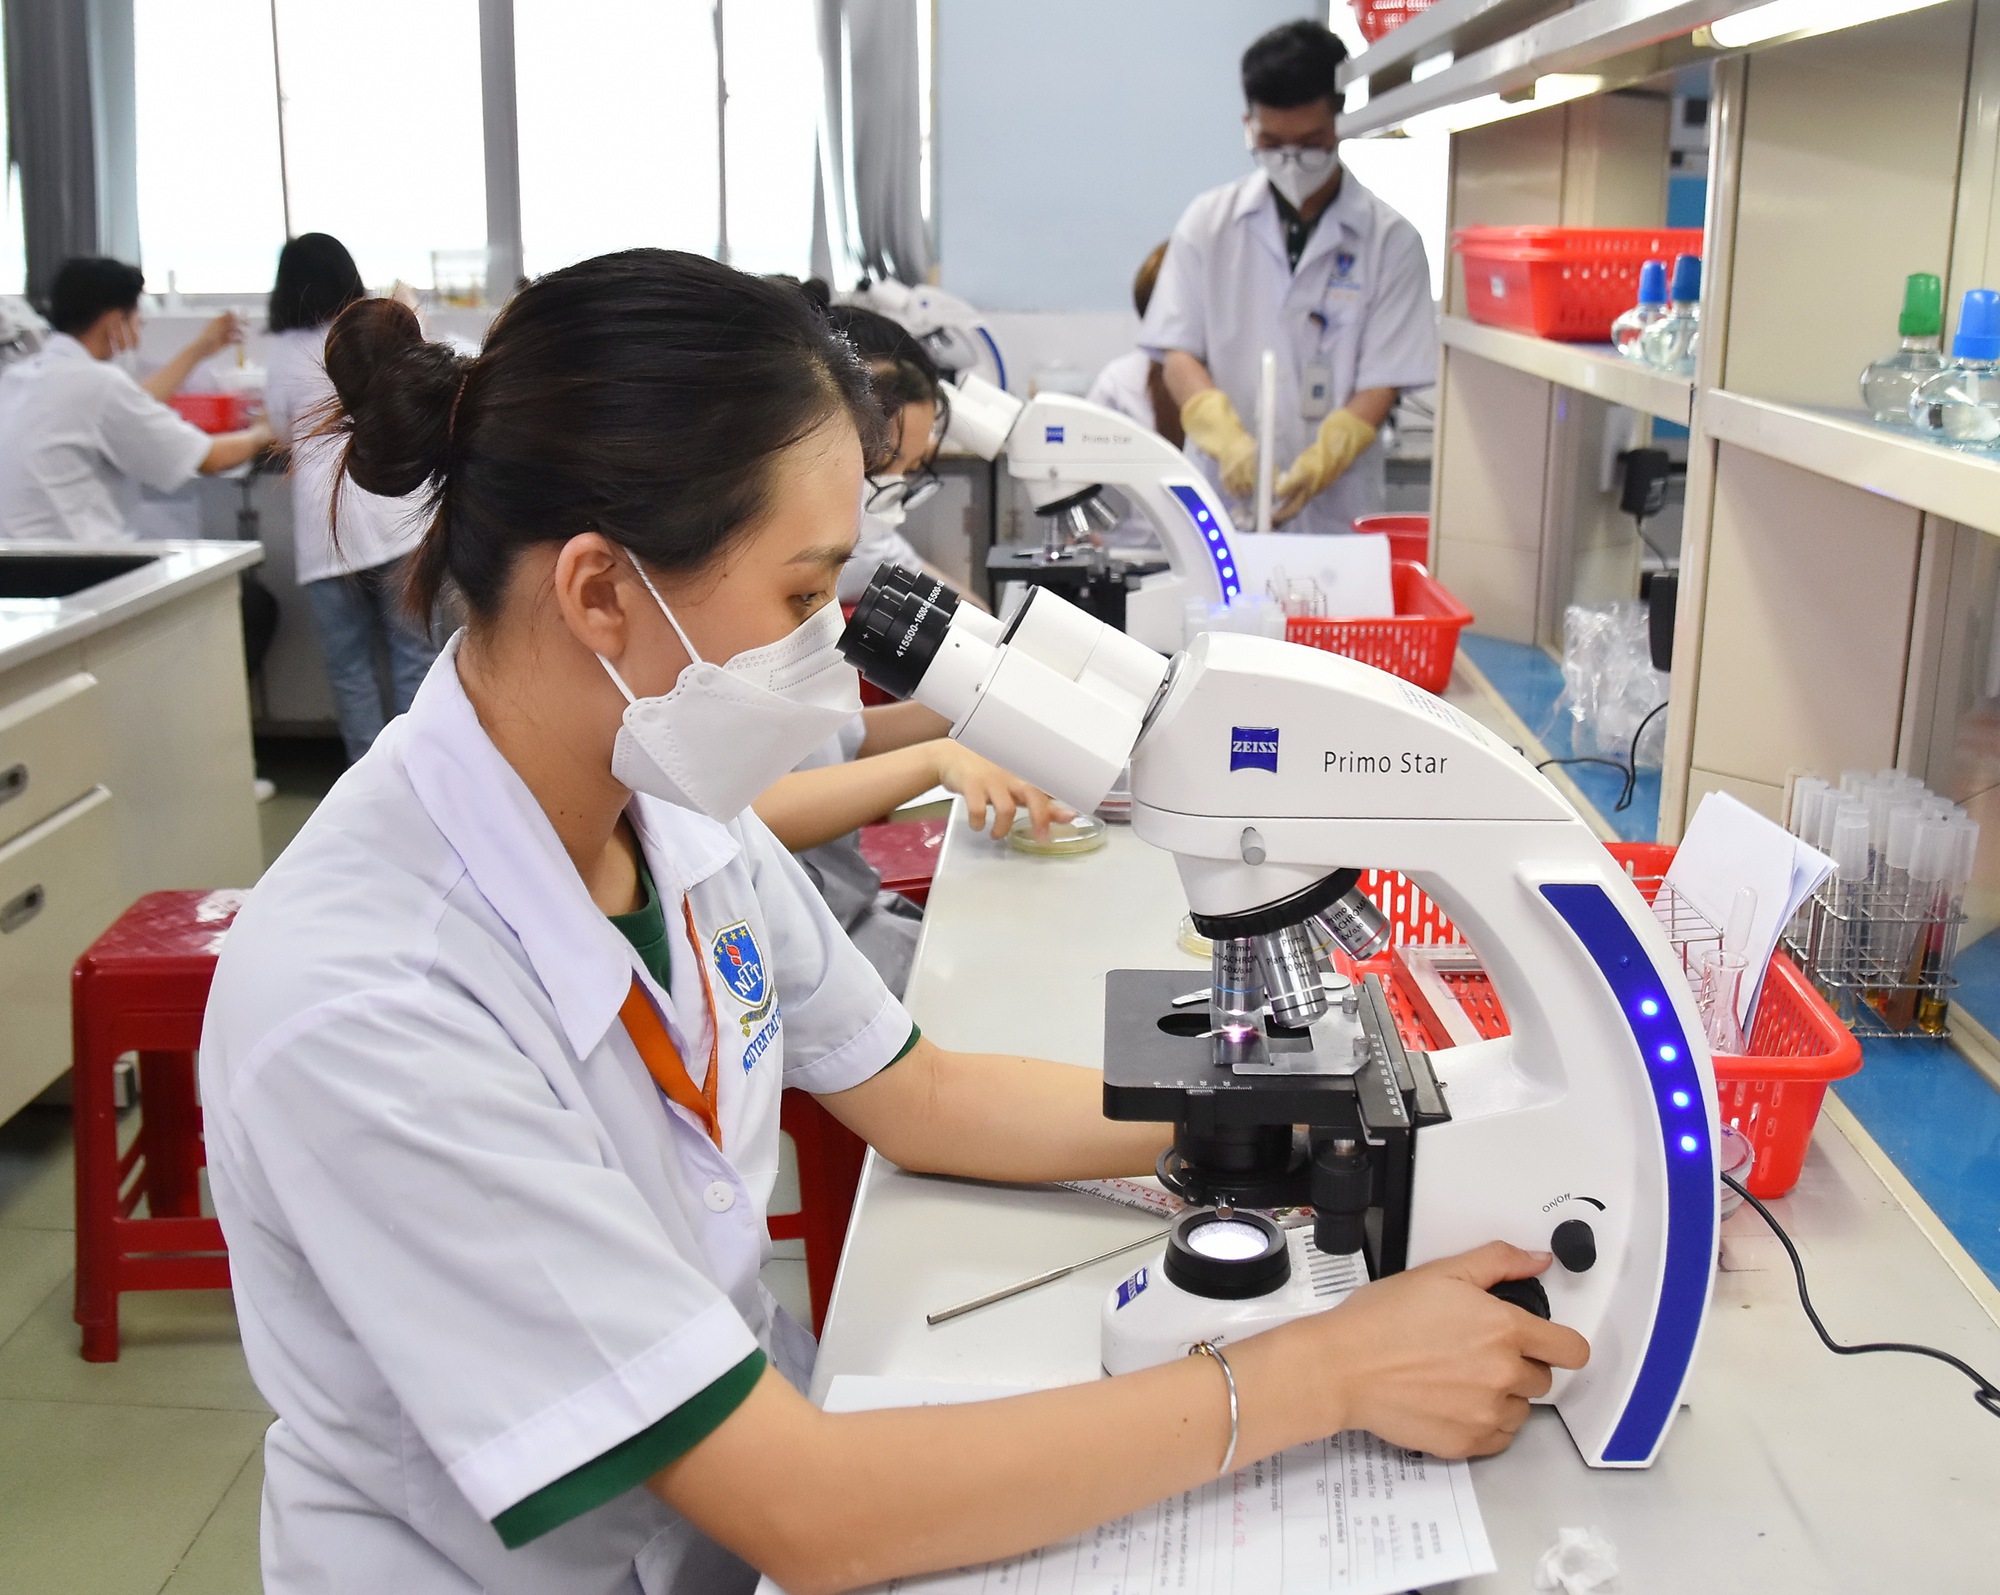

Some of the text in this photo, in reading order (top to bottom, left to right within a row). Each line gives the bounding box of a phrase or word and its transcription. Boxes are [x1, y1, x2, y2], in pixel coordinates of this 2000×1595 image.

[1233, 741, 1278, 753] ZEISS
[1324, 751, 1448, 774] Primo Star
[1325, 907, 1348, 925] Primo
[1226, 942, 1251, 953] Primo
[1542, 1193, 1571, 1213] On/Off
